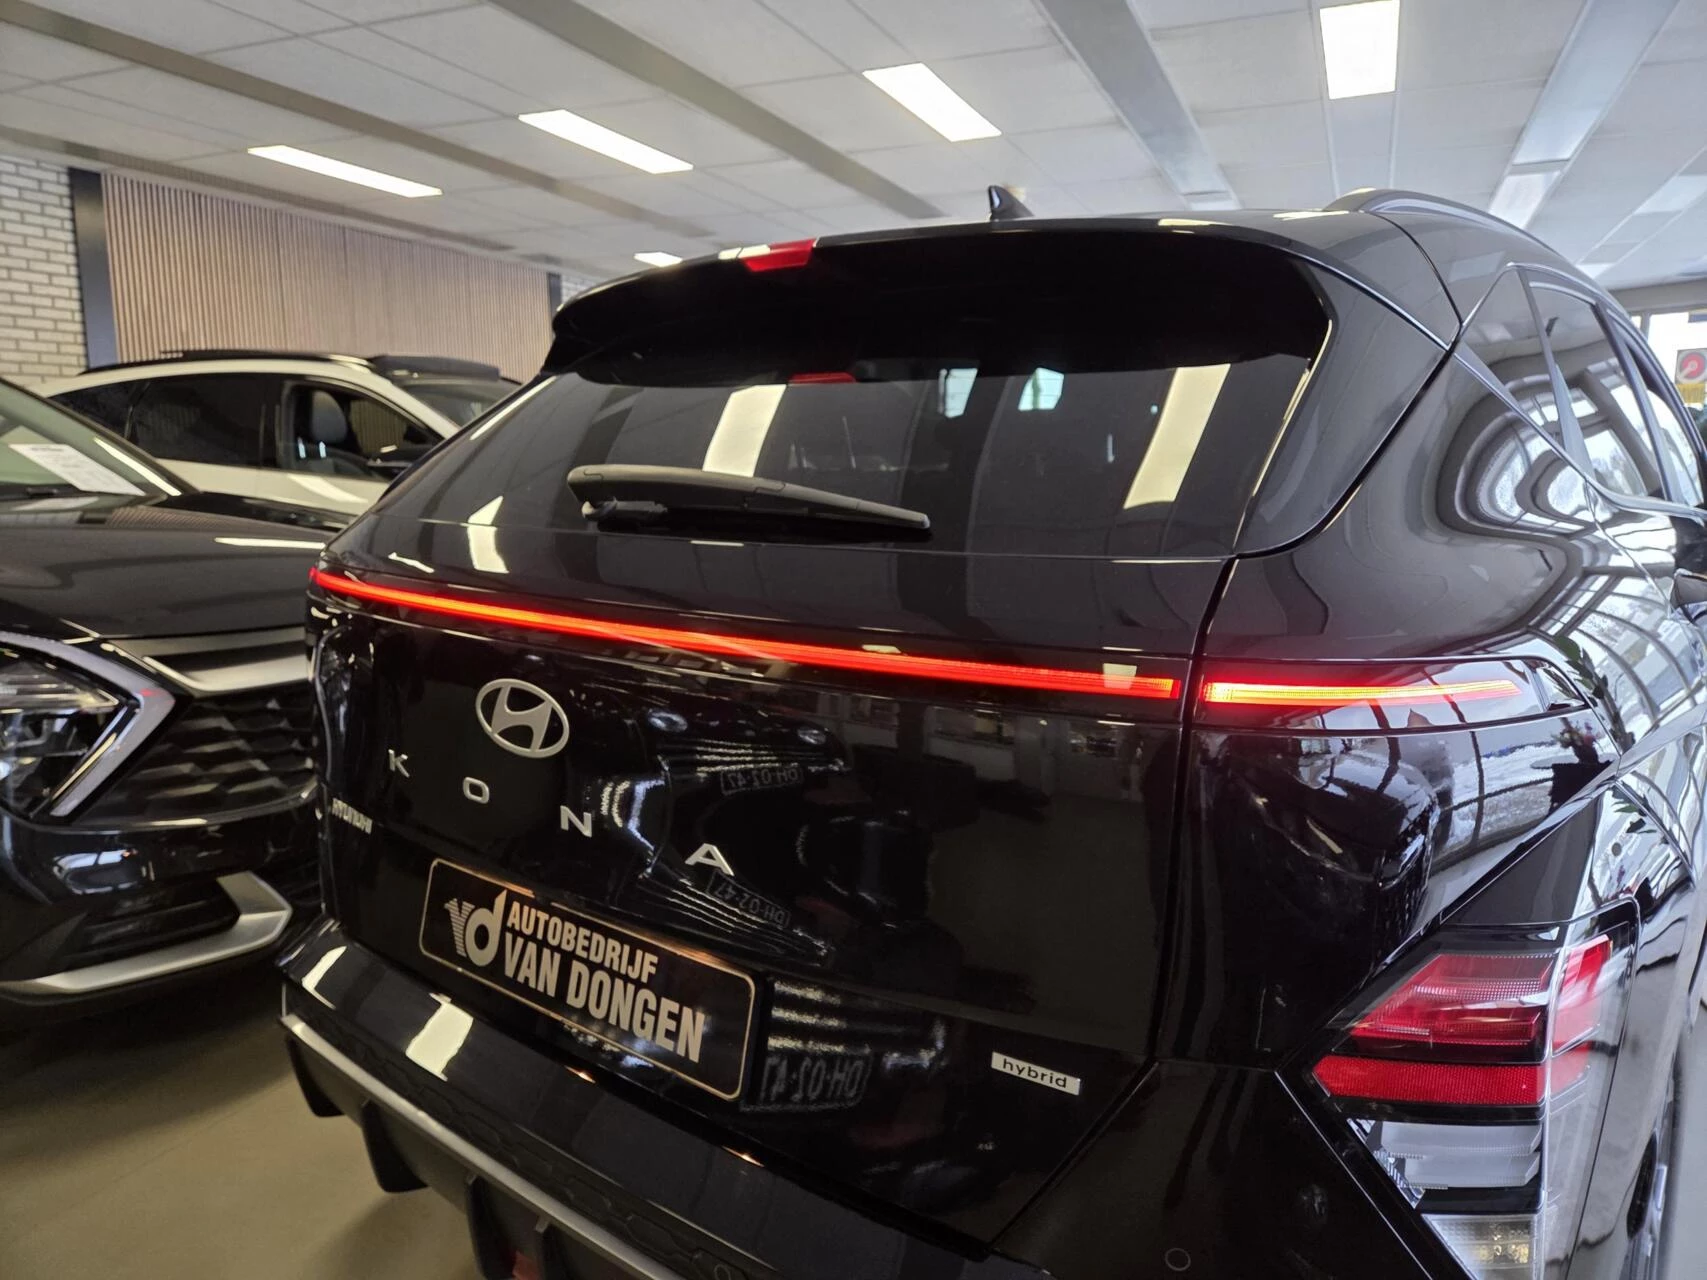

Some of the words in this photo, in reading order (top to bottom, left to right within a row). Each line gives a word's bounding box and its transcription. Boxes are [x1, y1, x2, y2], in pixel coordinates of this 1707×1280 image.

[507, 901, 658, 983] AUTOBEDRIJF
[504, 932, 561, 998] VAN
[566, 960, 704, 1063] DONGEN
[1003, 1058, 1067, 1088] hybrid
